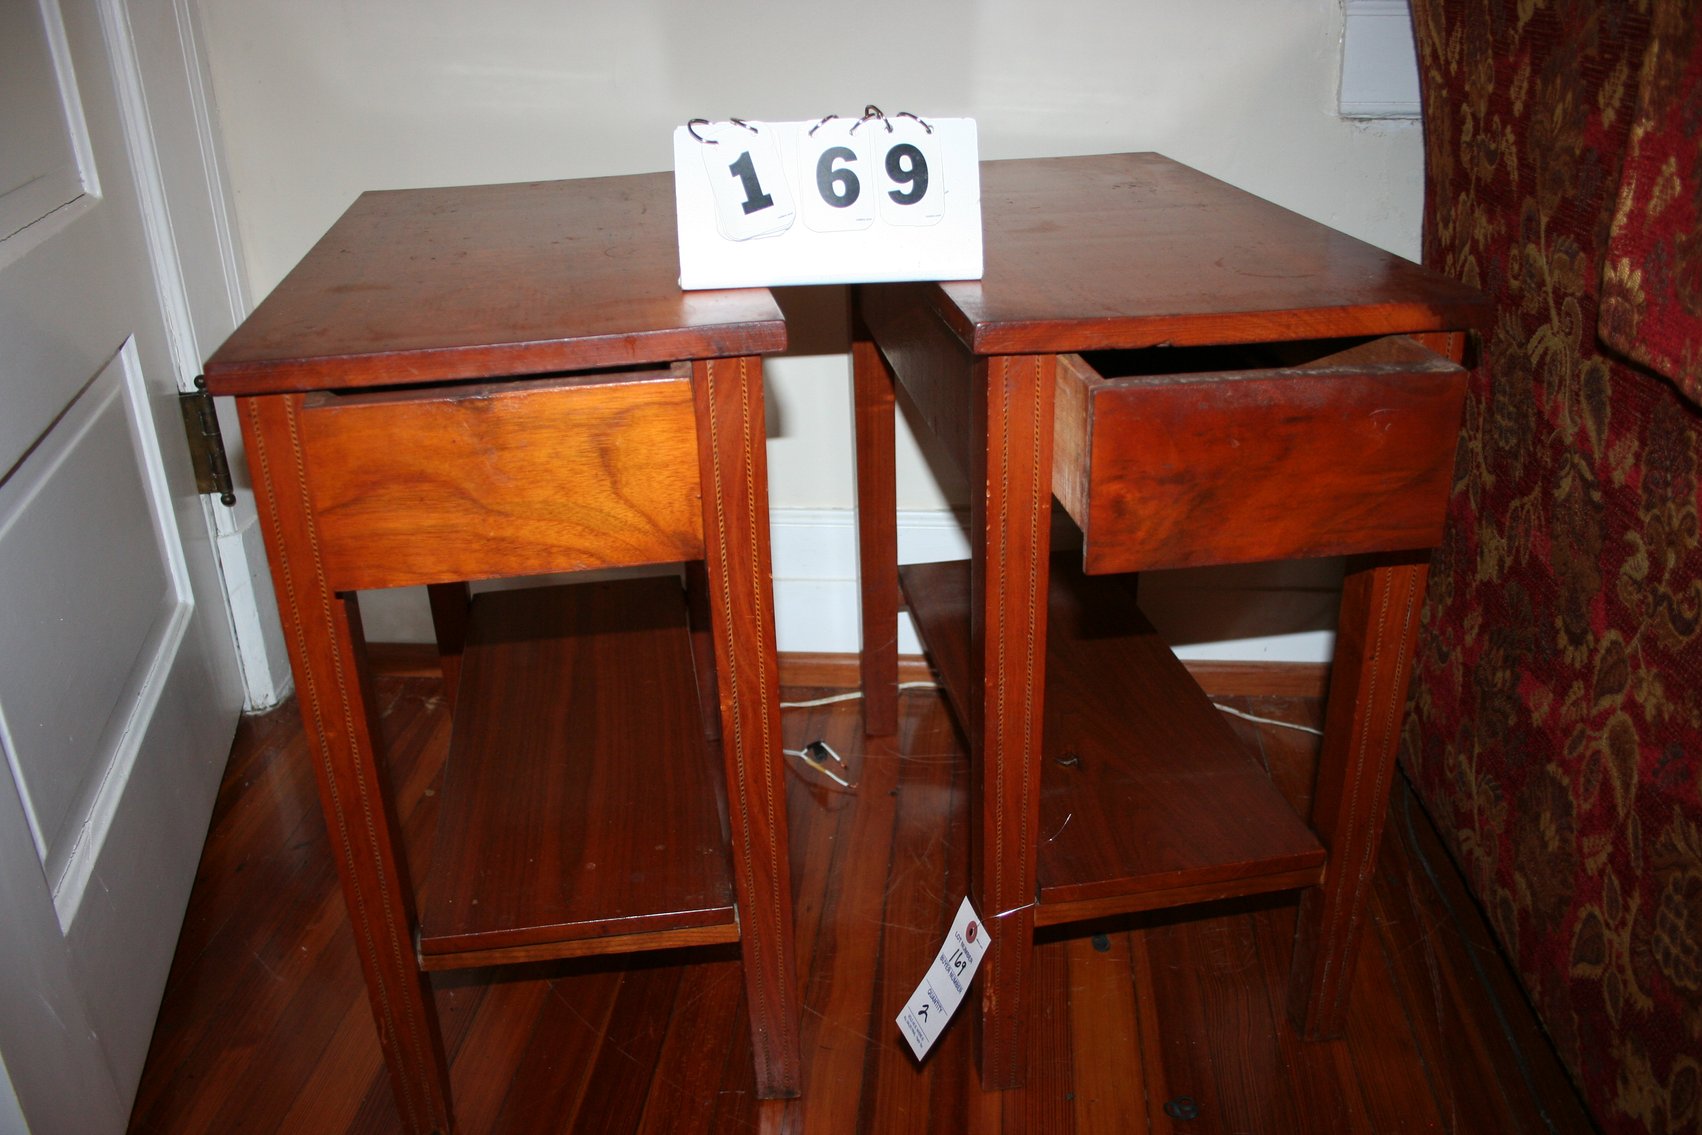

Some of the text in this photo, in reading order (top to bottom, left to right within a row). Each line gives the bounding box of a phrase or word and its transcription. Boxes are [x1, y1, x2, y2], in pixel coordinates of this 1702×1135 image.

[939, 953, 963, 994] BUYER NUMBER
[949, 948, 967, 976] 169
[918, 1004, 929, 1023] 2
[927, 988, 943, 1013] QUANTITY
